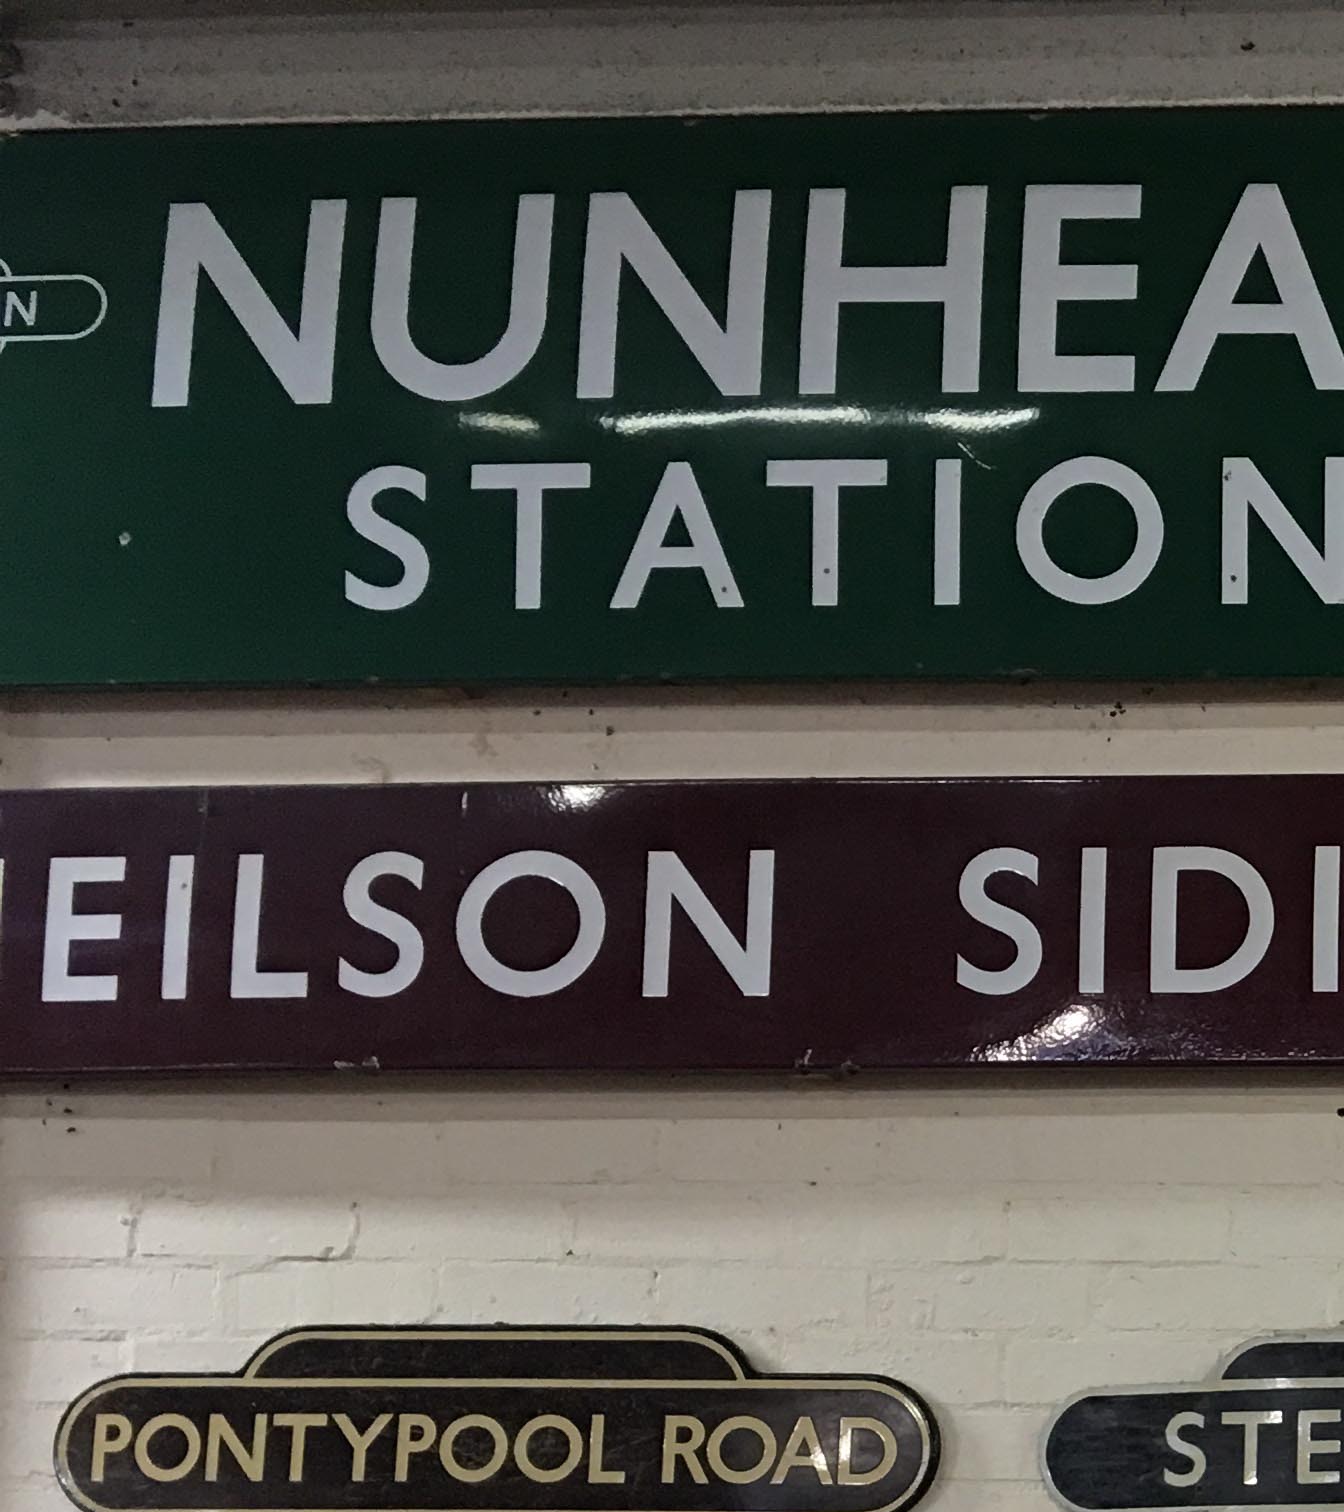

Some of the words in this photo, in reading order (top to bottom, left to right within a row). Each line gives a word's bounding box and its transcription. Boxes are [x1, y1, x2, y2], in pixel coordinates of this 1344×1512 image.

[0, 850, 774, 1002] EILSON
[91, 1414, 625, 1483] PONTYPOOL
[662, 1416, 897, 1485] ROAD
